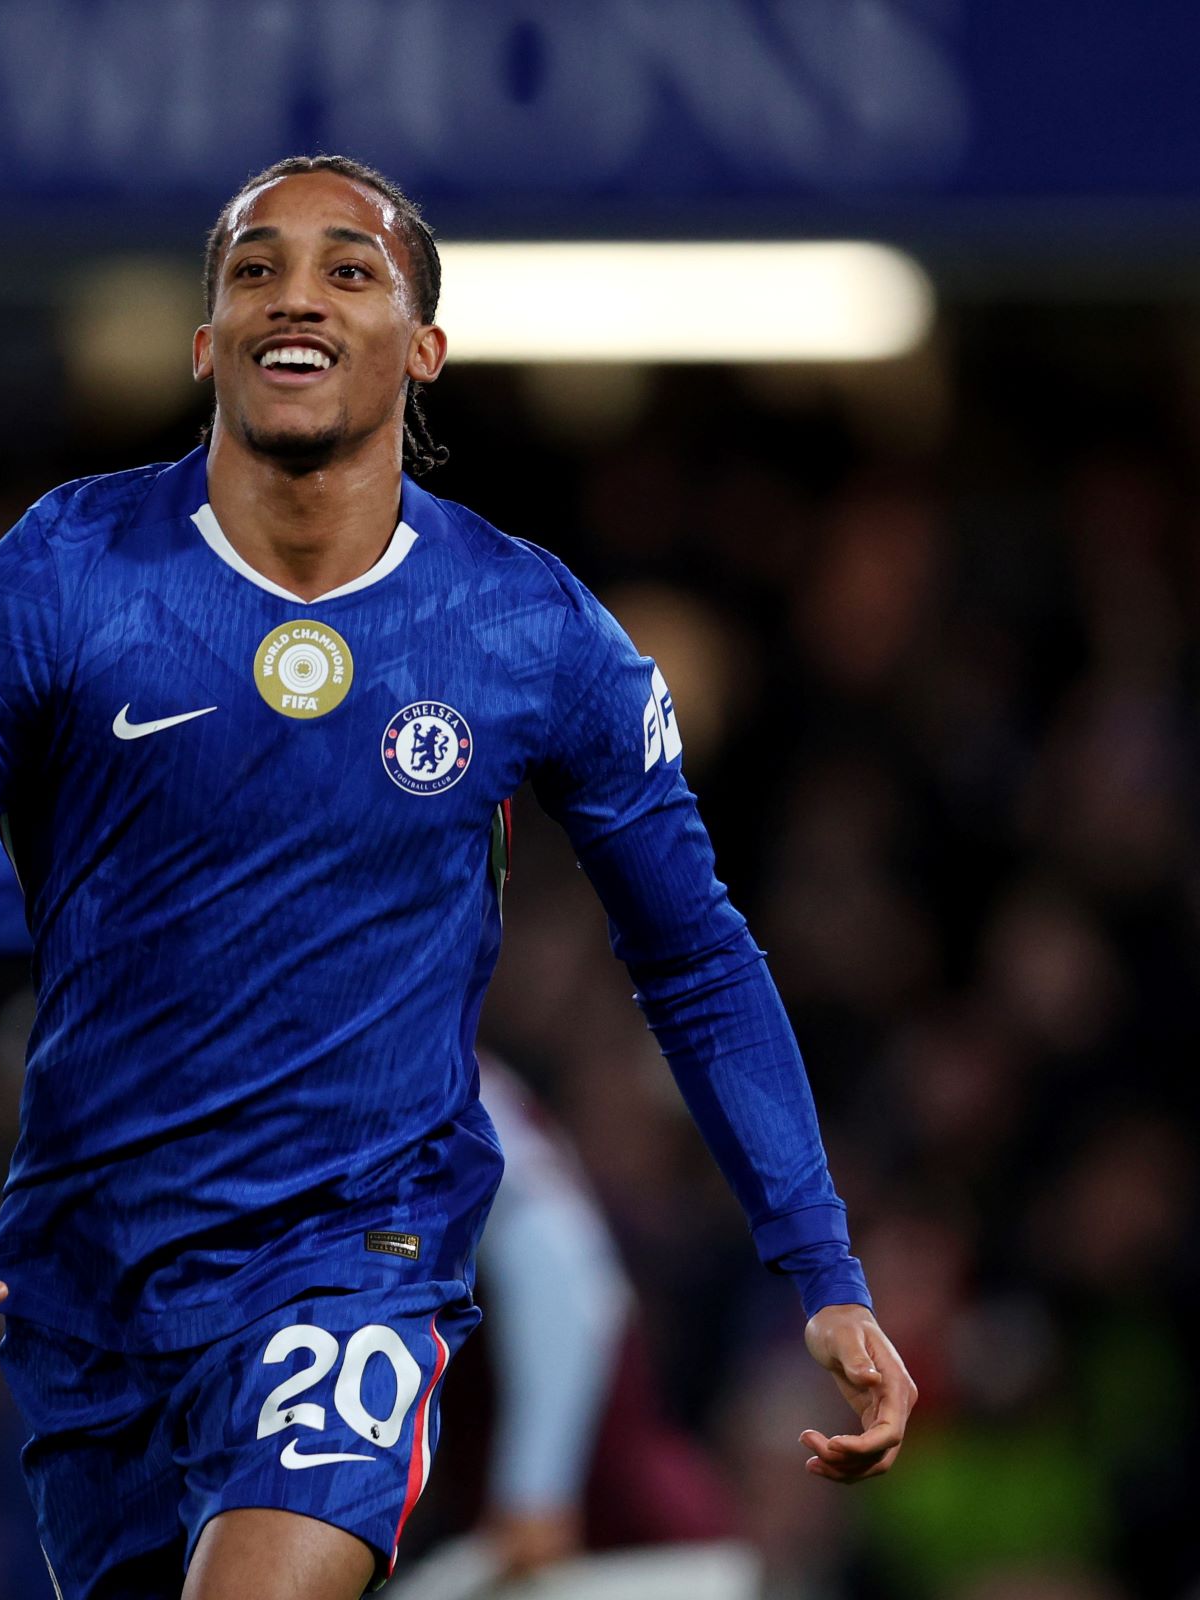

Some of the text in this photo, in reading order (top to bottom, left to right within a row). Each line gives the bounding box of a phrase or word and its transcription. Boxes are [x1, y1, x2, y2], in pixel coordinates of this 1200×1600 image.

[263, 628, 345, 685] WORLD CHAMPIONS
[281, 694, 318, 711] FIFA
[402, 705, 460, 729] CHELSEA
[393, 769, 452, 790] FOOTBALL CLUB
[256, 1323, 422, 1448] 20
